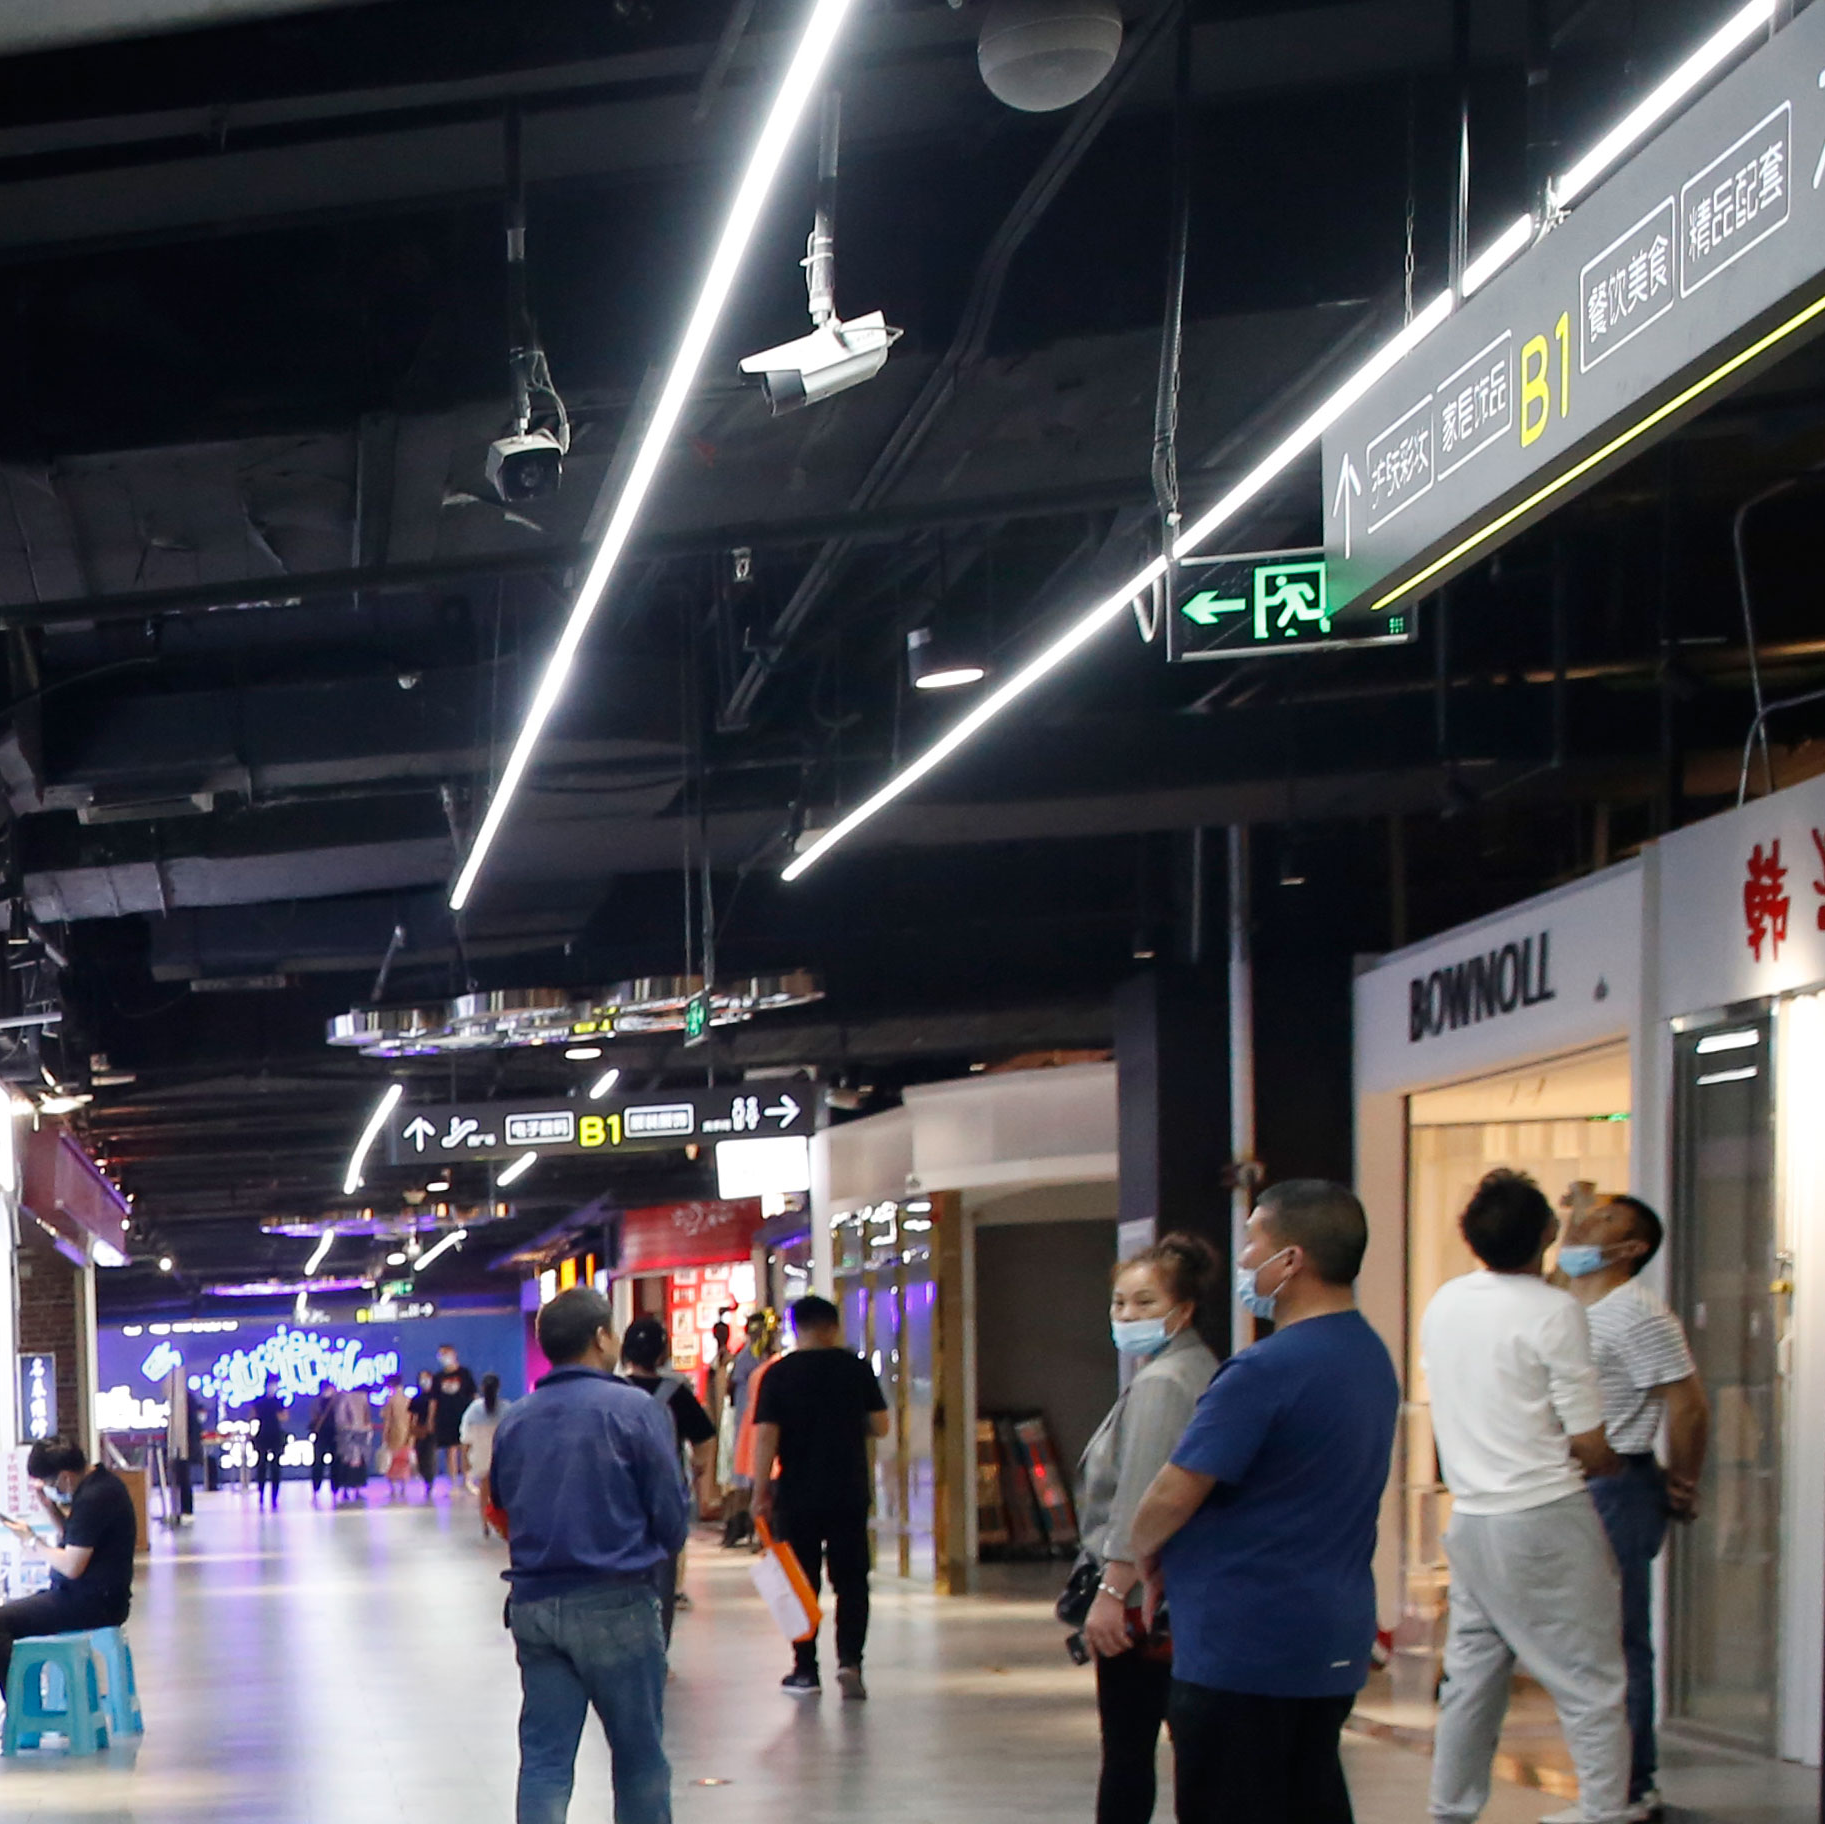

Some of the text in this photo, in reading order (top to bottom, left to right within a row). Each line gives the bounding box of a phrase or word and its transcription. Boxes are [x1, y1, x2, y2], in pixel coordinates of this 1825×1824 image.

[1521, 312, 1569, 448] B1
[1587, 233, 1669, 343] 餐饮美食
[1687, 140, 1785, 263] 精品配套
[1409, 932, 1556, 1042] BOWNOLL
[578, 1114, 622, 1147] B1
